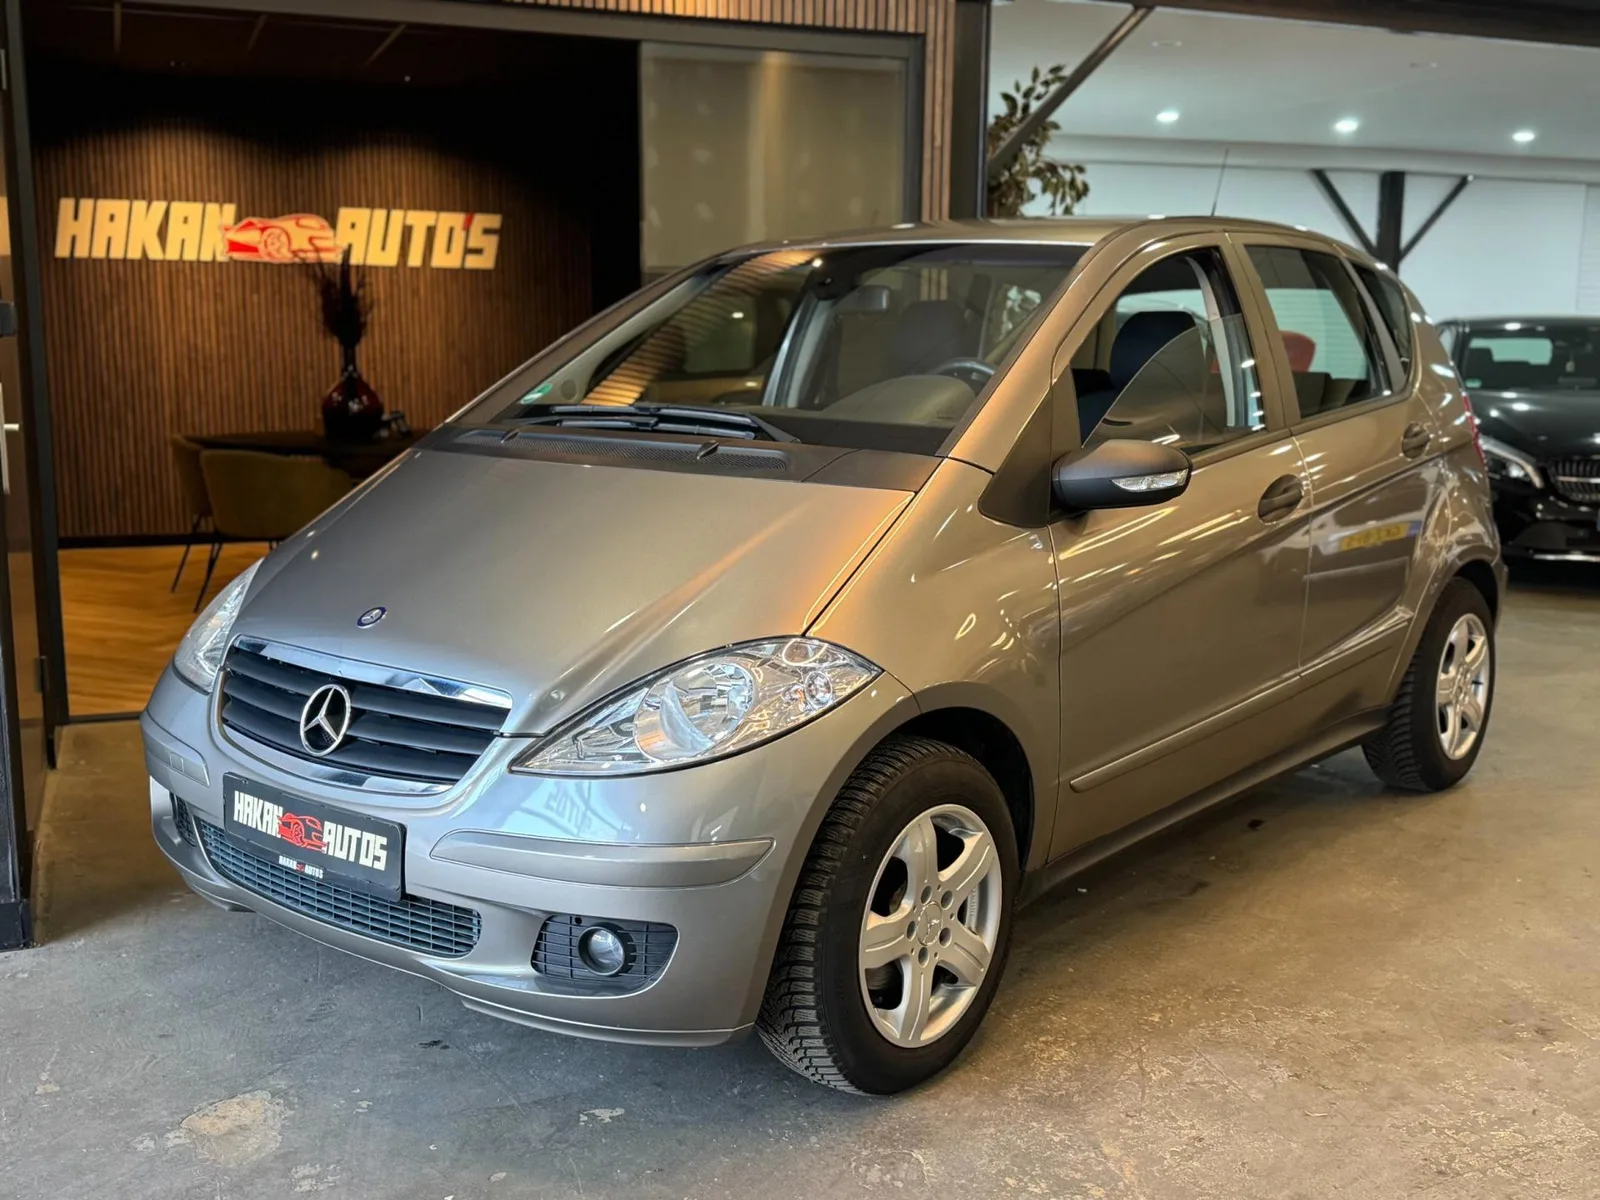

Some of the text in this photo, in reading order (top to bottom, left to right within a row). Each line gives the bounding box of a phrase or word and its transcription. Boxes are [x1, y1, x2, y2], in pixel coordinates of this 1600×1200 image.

[54, 197, 502, 270] HAKAN AUTO'S
[233, 790, 388, 871] HAKAN AUTOS
